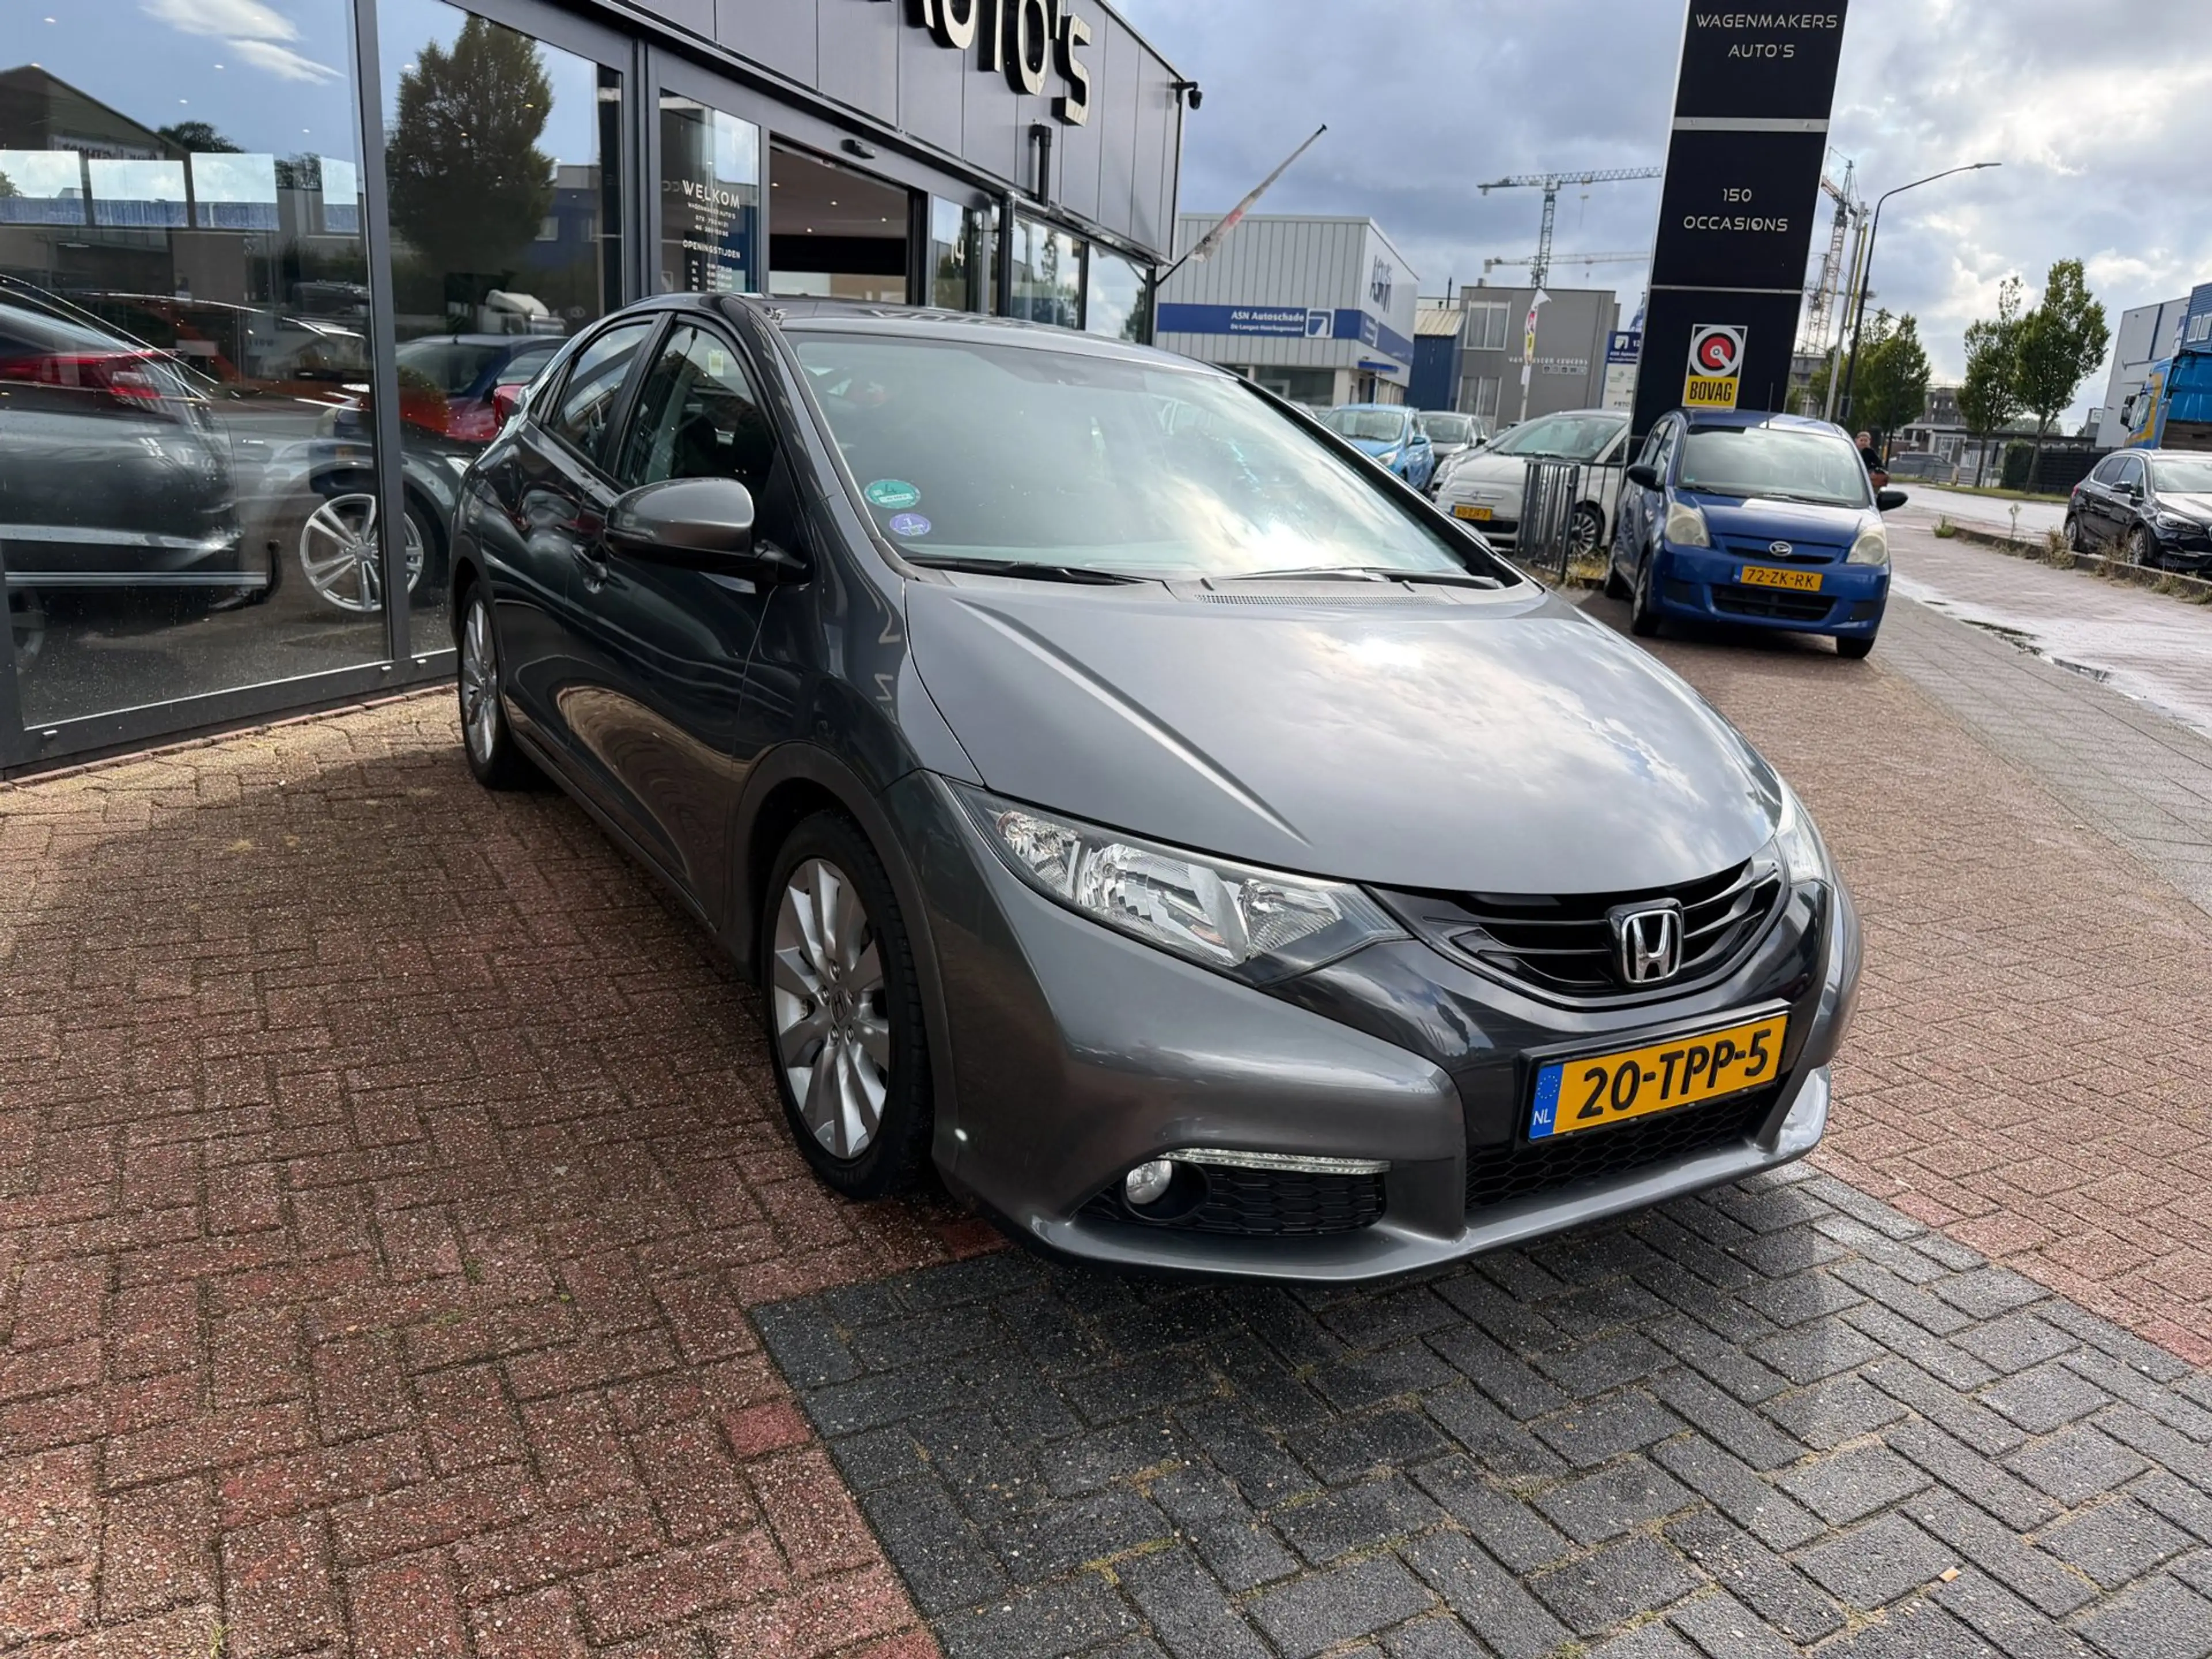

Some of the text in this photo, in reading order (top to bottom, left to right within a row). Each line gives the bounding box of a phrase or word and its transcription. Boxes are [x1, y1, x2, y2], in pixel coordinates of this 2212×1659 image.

[1696, 14, 1838, 29] WAGENMAKERS
[1728, 44, 1795, 58] AUTO'S
[682, 179, 740, 209] WELKOM
[1723, 188, 1752, 202] 150
[1683, 216, 1789, 232] OCCASIONS
[683, 240, 740, 259] OPENINGSTIJDEN
[951, 240, 965, 267] 14
[1231, 310, 1305, 322] ASN Autoschade
[1689, 381, 1733, 402] BOVAG
[1747, 568, 1815, 588] 72-ZK-RK
[1532, 1029, 1772, 1124] NL 20-TPP-5
